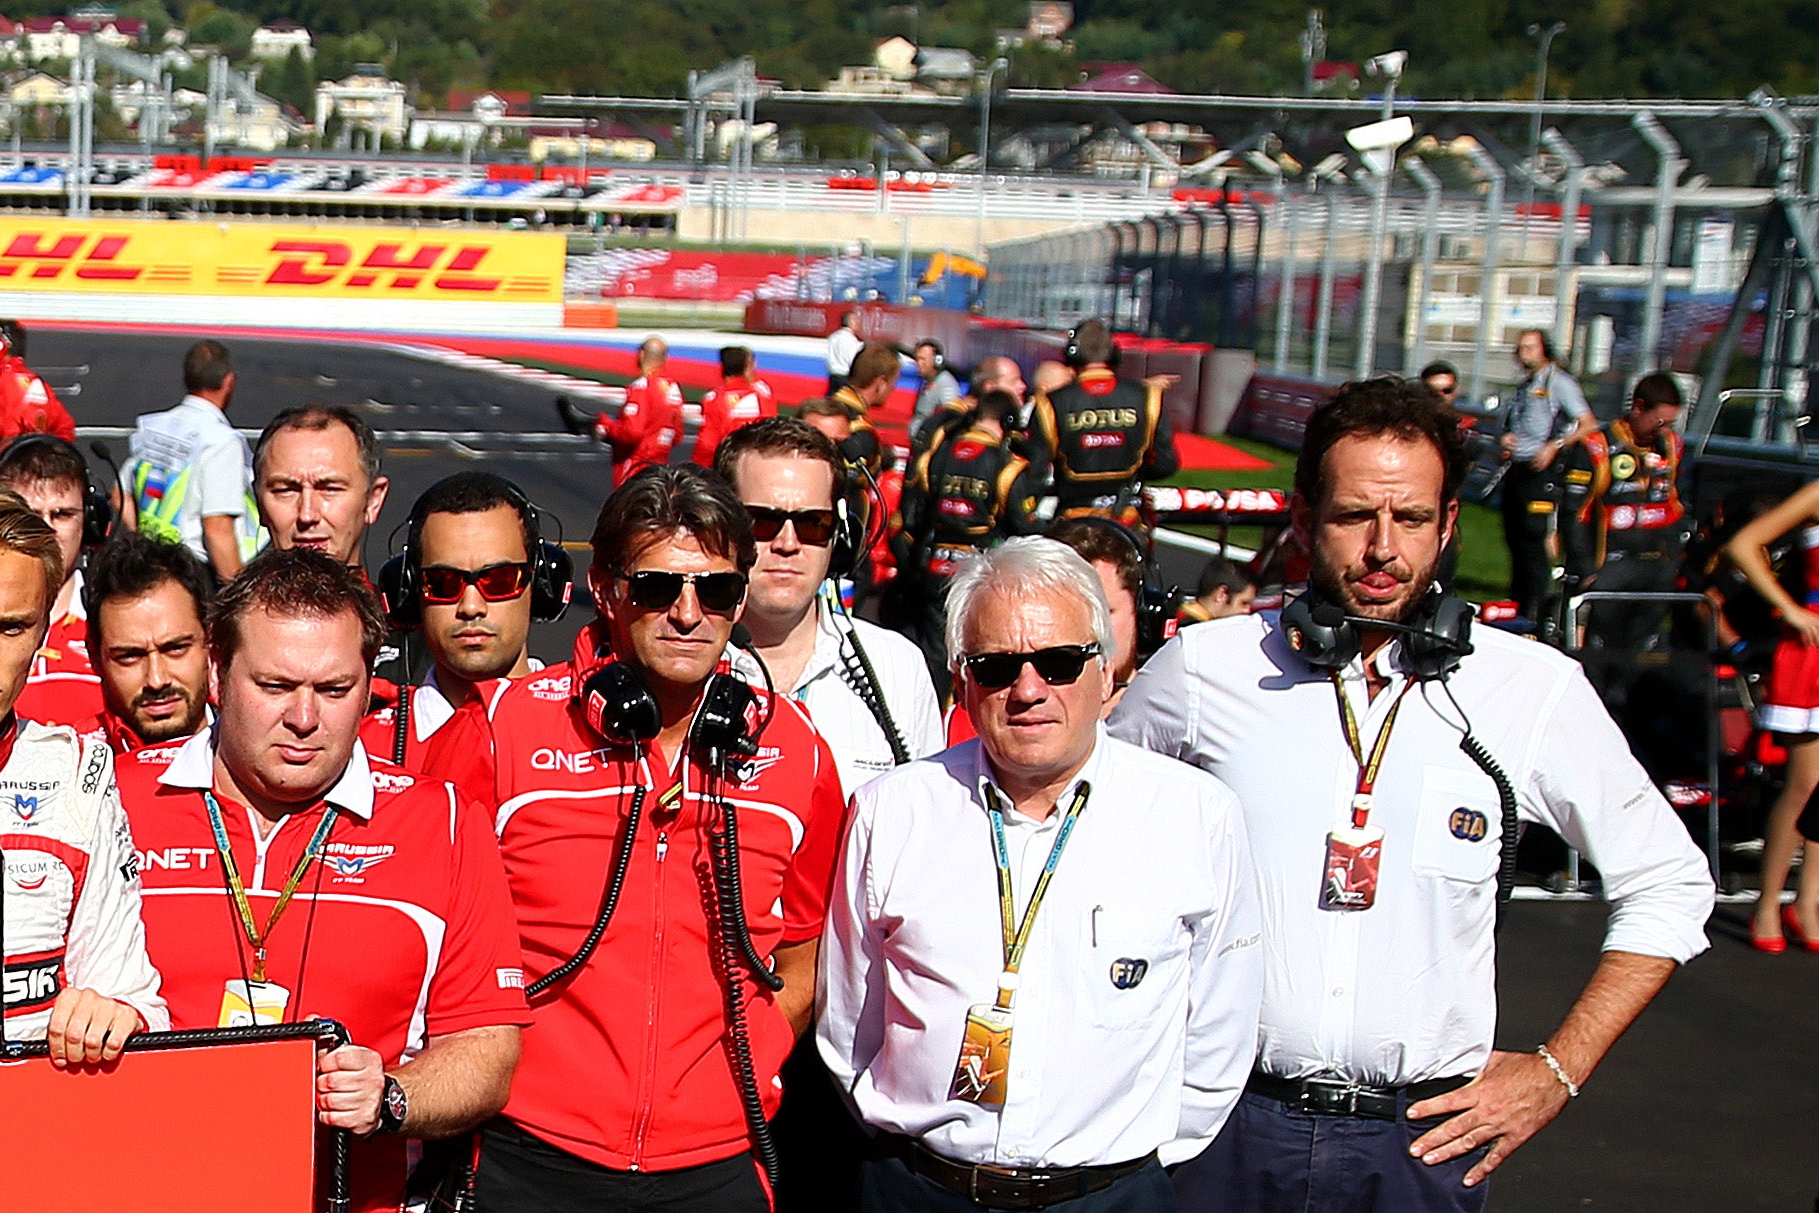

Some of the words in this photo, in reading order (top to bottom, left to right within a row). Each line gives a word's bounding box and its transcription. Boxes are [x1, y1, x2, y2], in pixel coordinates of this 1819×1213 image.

[265, 240, 502, 290] DHL
[1068, 409, 1138, 430] LOTUS
[528, 676, 572, 692] one
[531, 749, 613, 774] QNET
[371, 772, 416, 787] one
